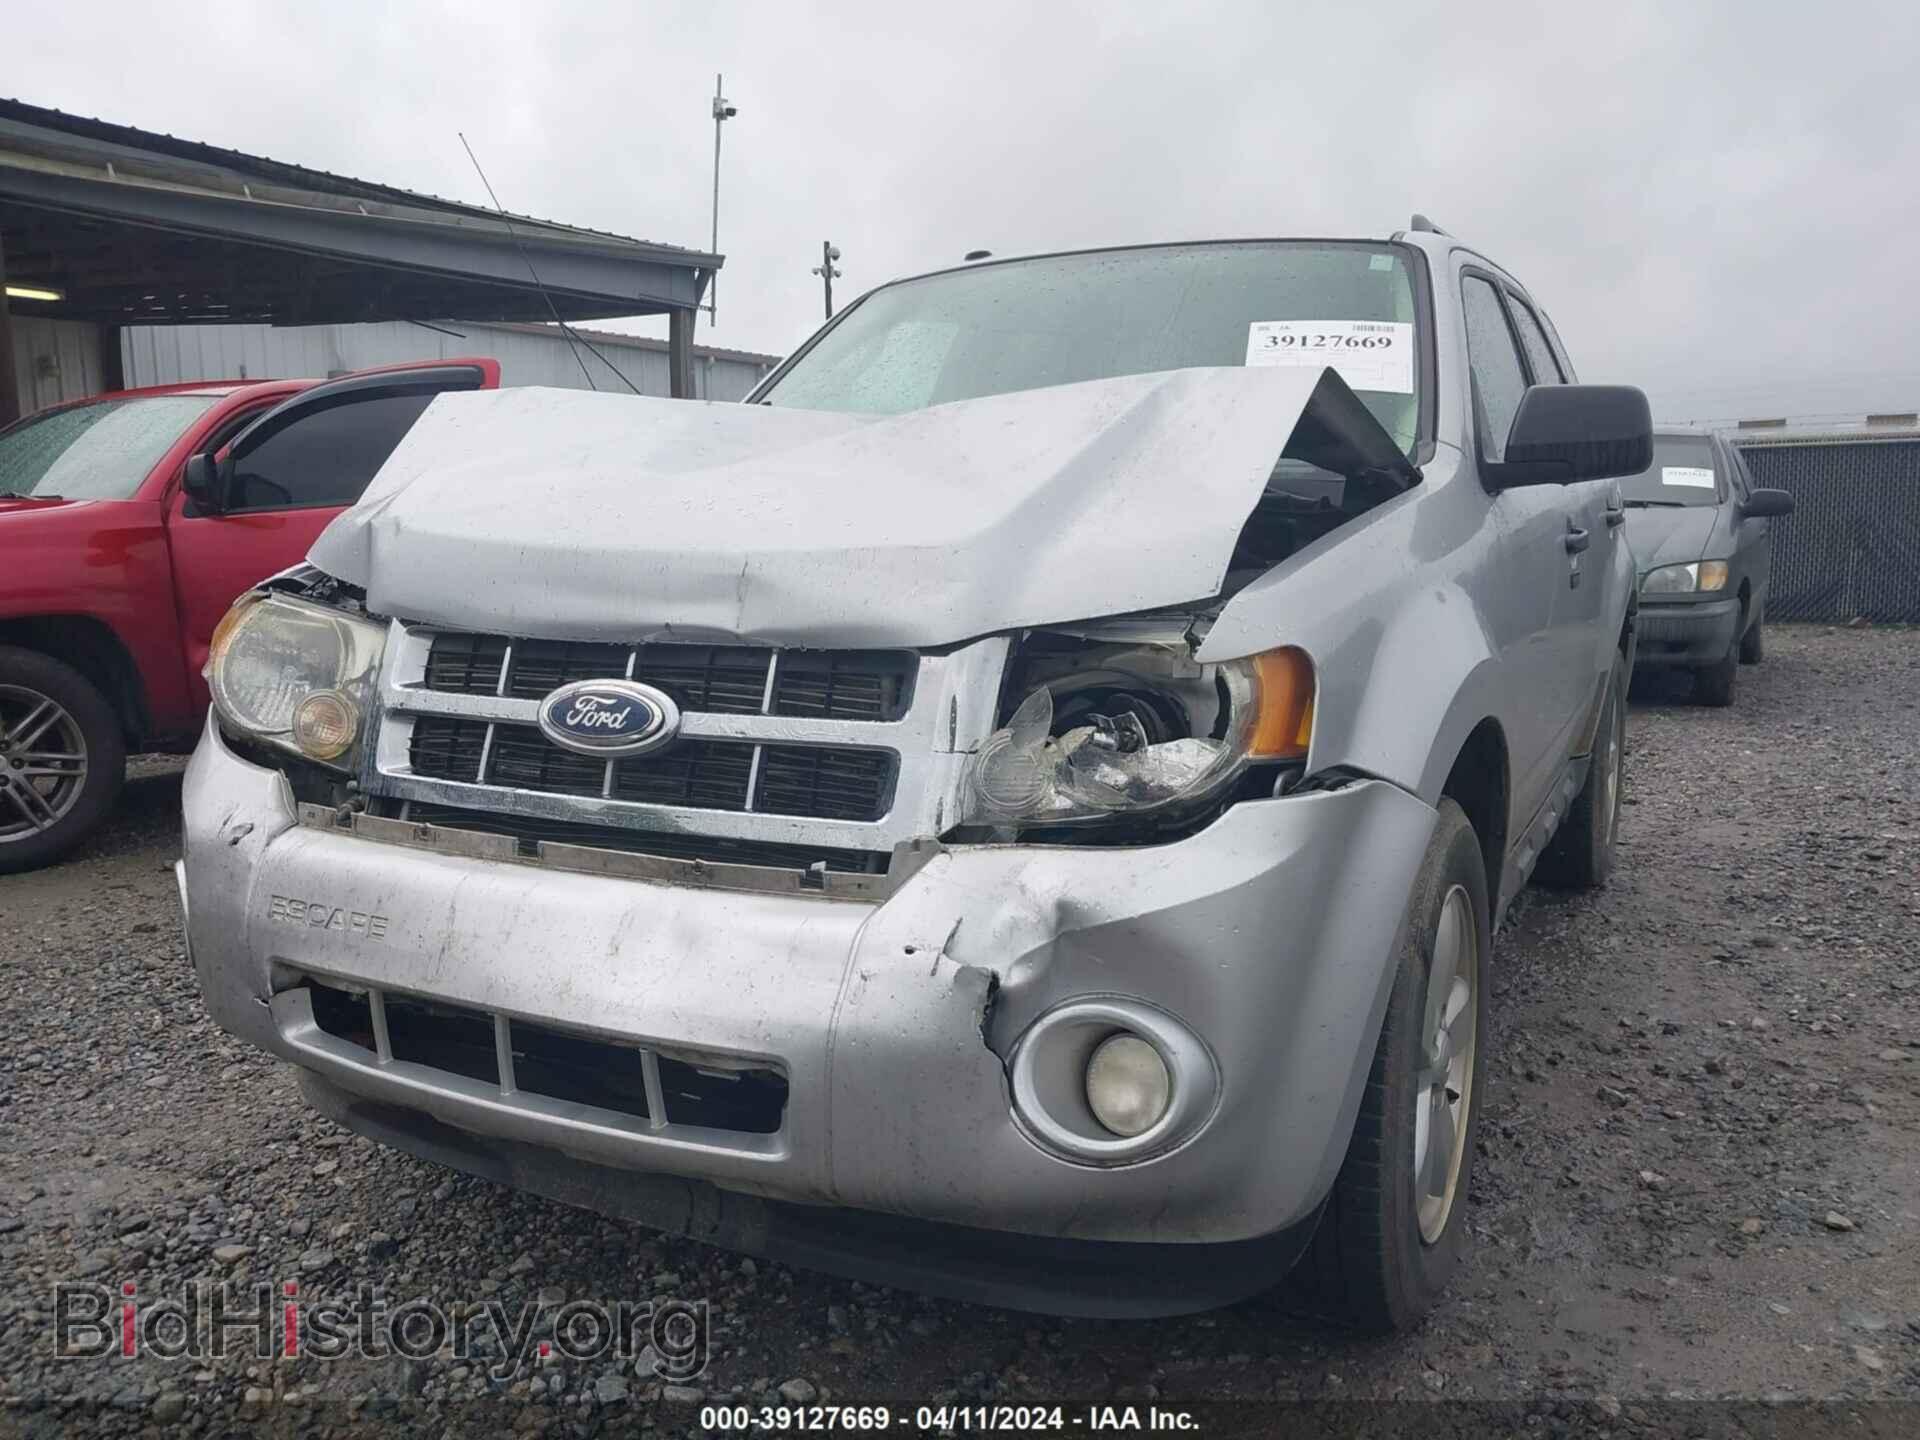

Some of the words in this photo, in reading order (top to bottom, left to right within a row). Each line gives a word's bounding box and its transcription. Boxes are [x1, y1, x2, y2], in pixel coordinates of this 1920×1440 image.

[1264, 335, 1392, 349] 39127669
[566, 695, 631, 729] Ford
[268, 894, 389, 941] ESCAPE
